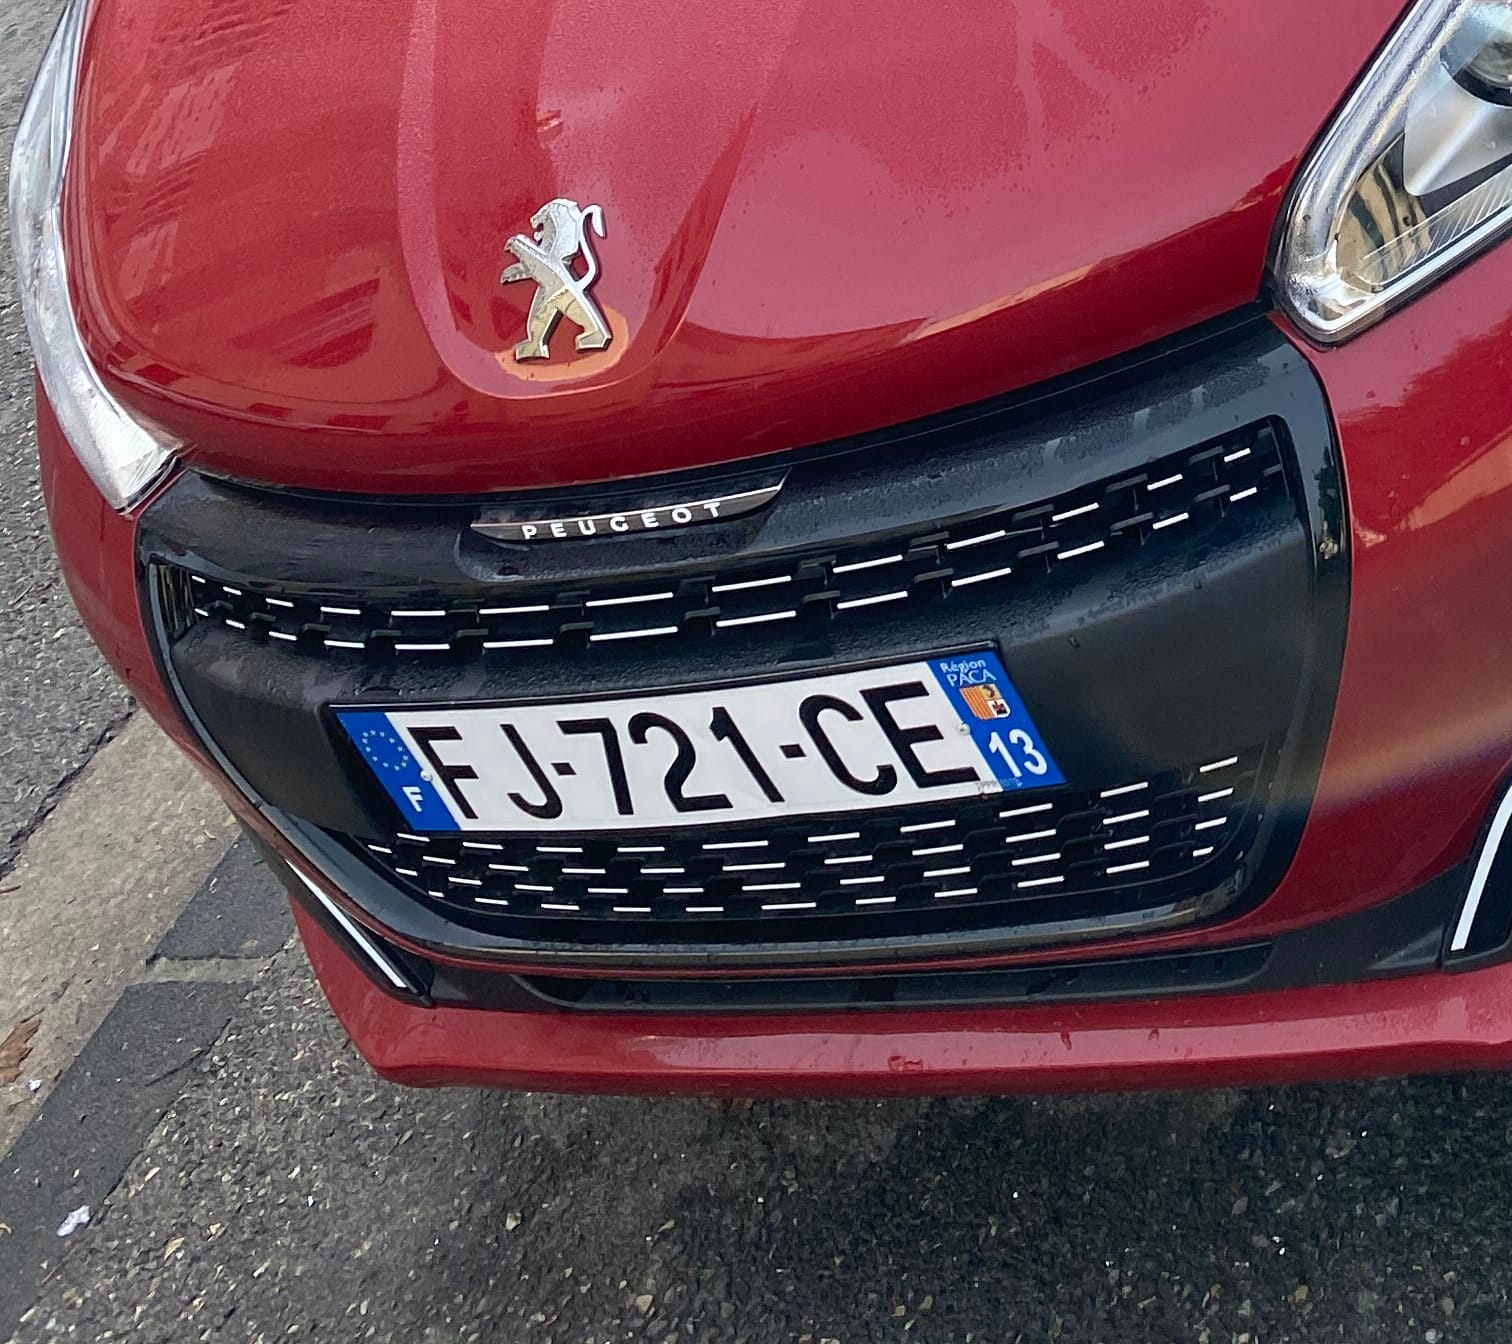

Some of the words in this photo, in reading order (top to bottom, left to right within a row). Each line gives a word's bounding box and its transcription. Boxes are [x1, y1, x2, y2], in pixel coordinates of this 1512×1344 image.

[521, 502, 721, 540] PEUGEOT
[940, 659, 986, 675] Région
[946, 668, 997, 687] PACA
[407, 680, 979, 820] FJ-721-CE
[988, 728, 1048, 778] 13
[402, 785, 424, 813] F
